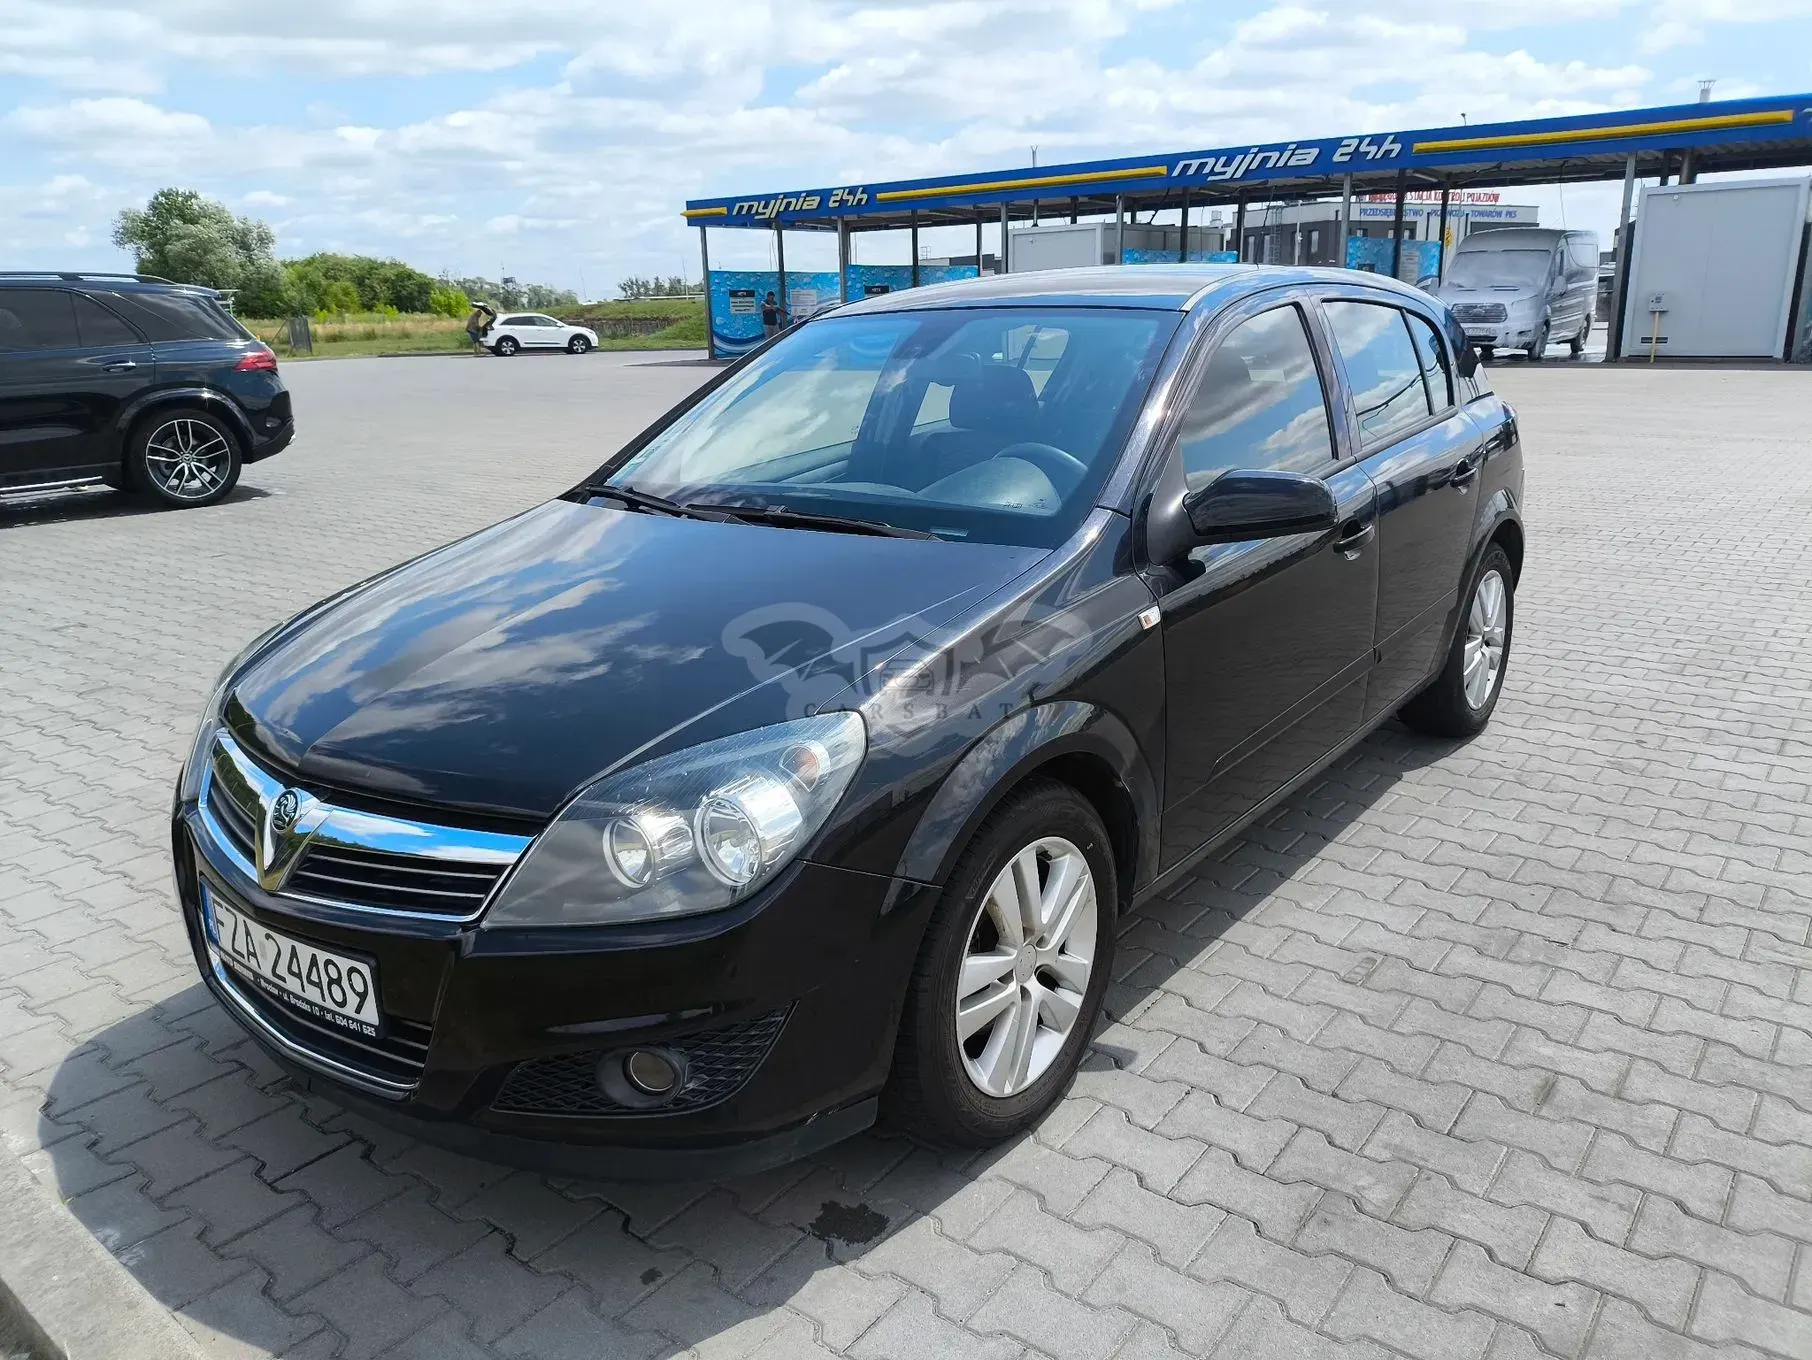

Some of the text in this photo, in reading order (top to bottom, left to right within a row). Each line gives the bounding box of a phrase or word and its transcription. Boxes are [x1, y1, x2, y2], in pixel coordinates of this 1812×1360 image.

[1171, 135, 1402, 181] myjnia 24h
[732, 187, 868, 219] myjnia 24h
[212, 898, 369, 1015] FZA 24489
